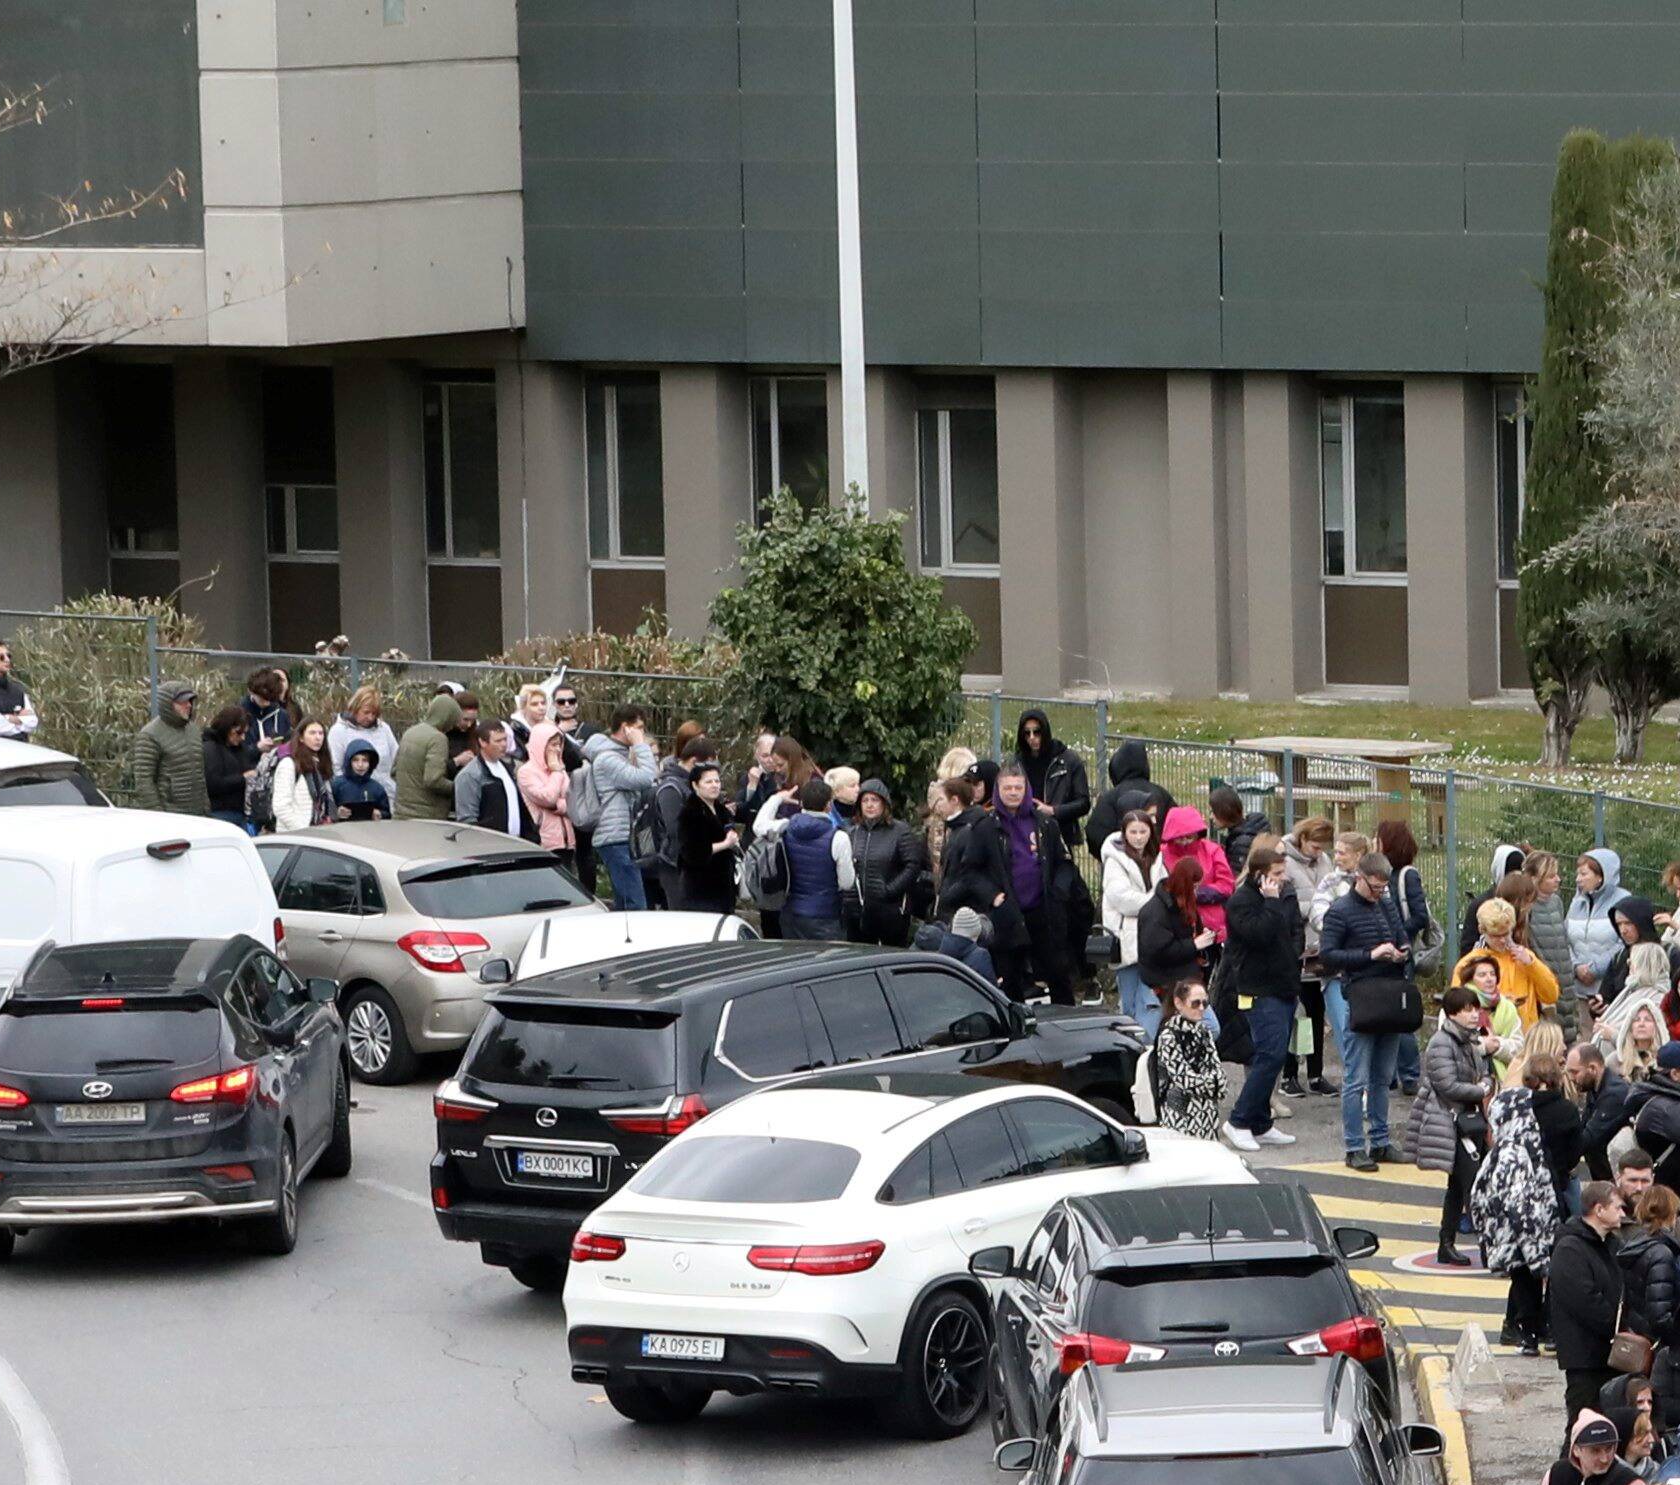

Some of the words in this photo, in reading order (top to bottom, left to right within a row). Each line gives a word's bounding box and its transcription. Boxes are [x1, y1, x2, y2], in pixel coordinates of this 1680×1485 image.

[65, 1106, 83, 1120] AA
[87, 1105, 117, 1119] 2002
[123, 1105, 141, 1119] TP
[650, 1335, 668, 1353] KA
[671, 1337, 699, 1354] 0975
